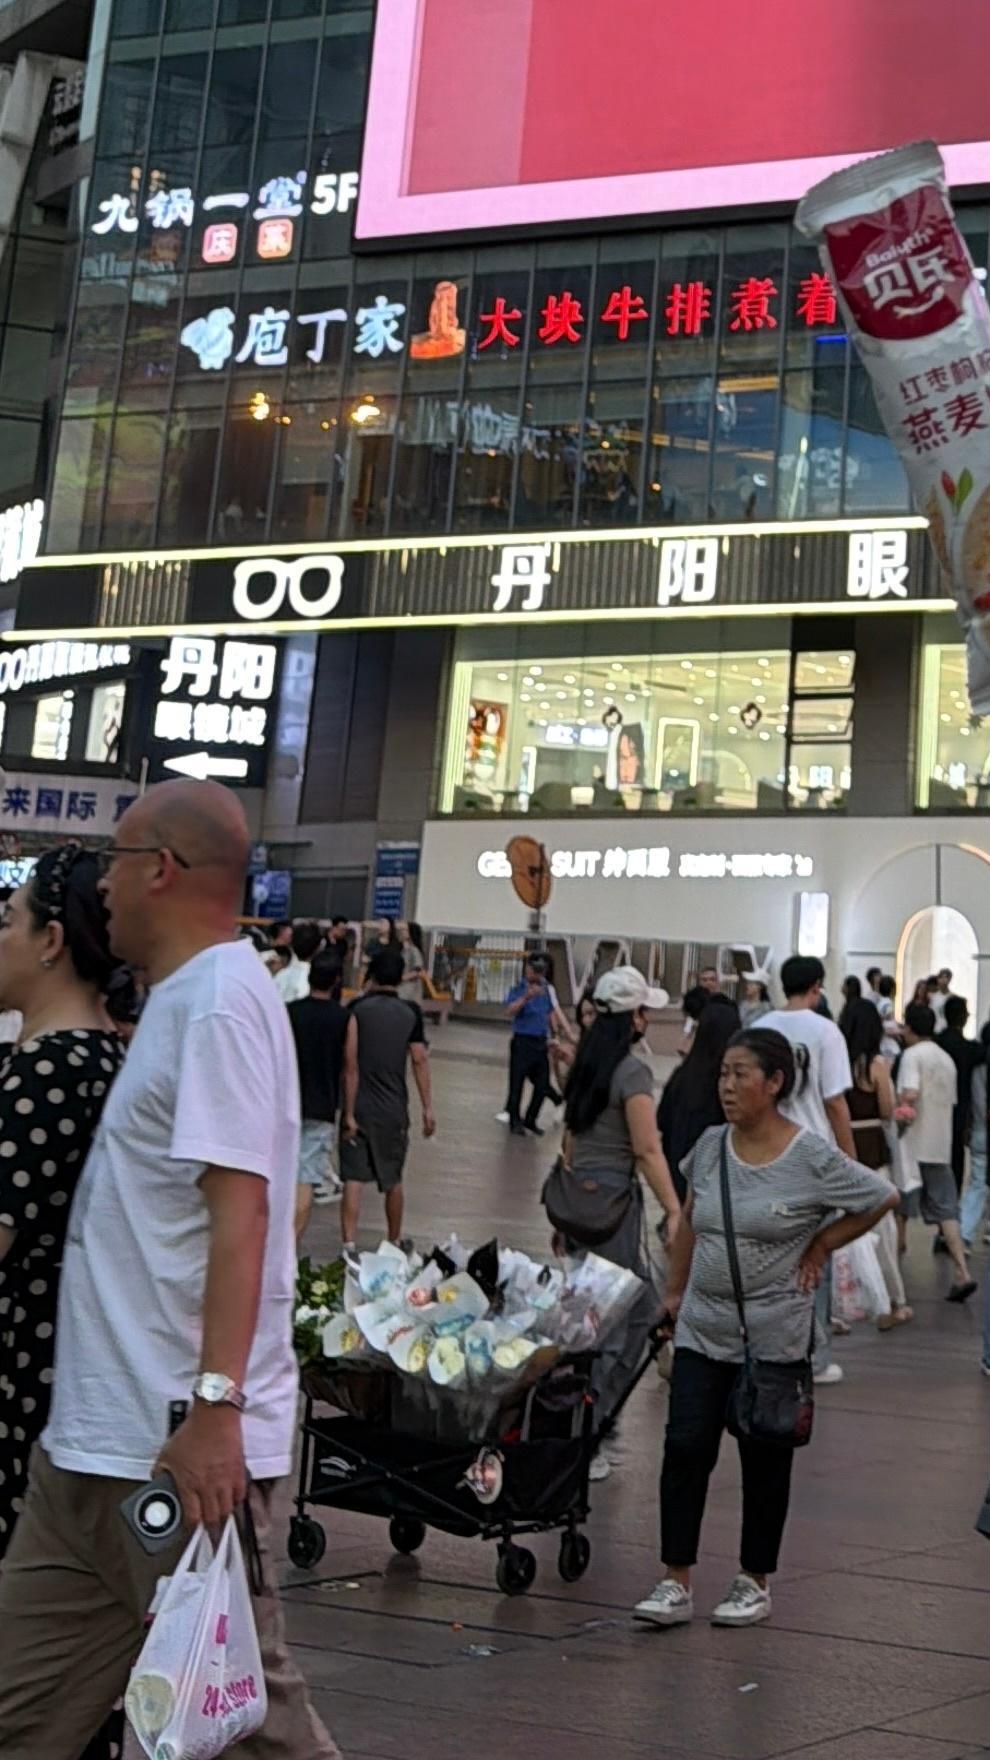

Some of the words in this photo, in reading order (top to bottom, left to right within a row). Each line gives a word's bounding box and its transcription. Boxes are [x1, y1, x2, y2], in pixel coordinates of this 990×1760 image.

[477, 271, 837, 350] 大块牛排煮着
[862, 244, 956, 311] 贝氏
[235, 294, 407, 367] 庖丁家
[160, 636, 278, 700] 丹阳
